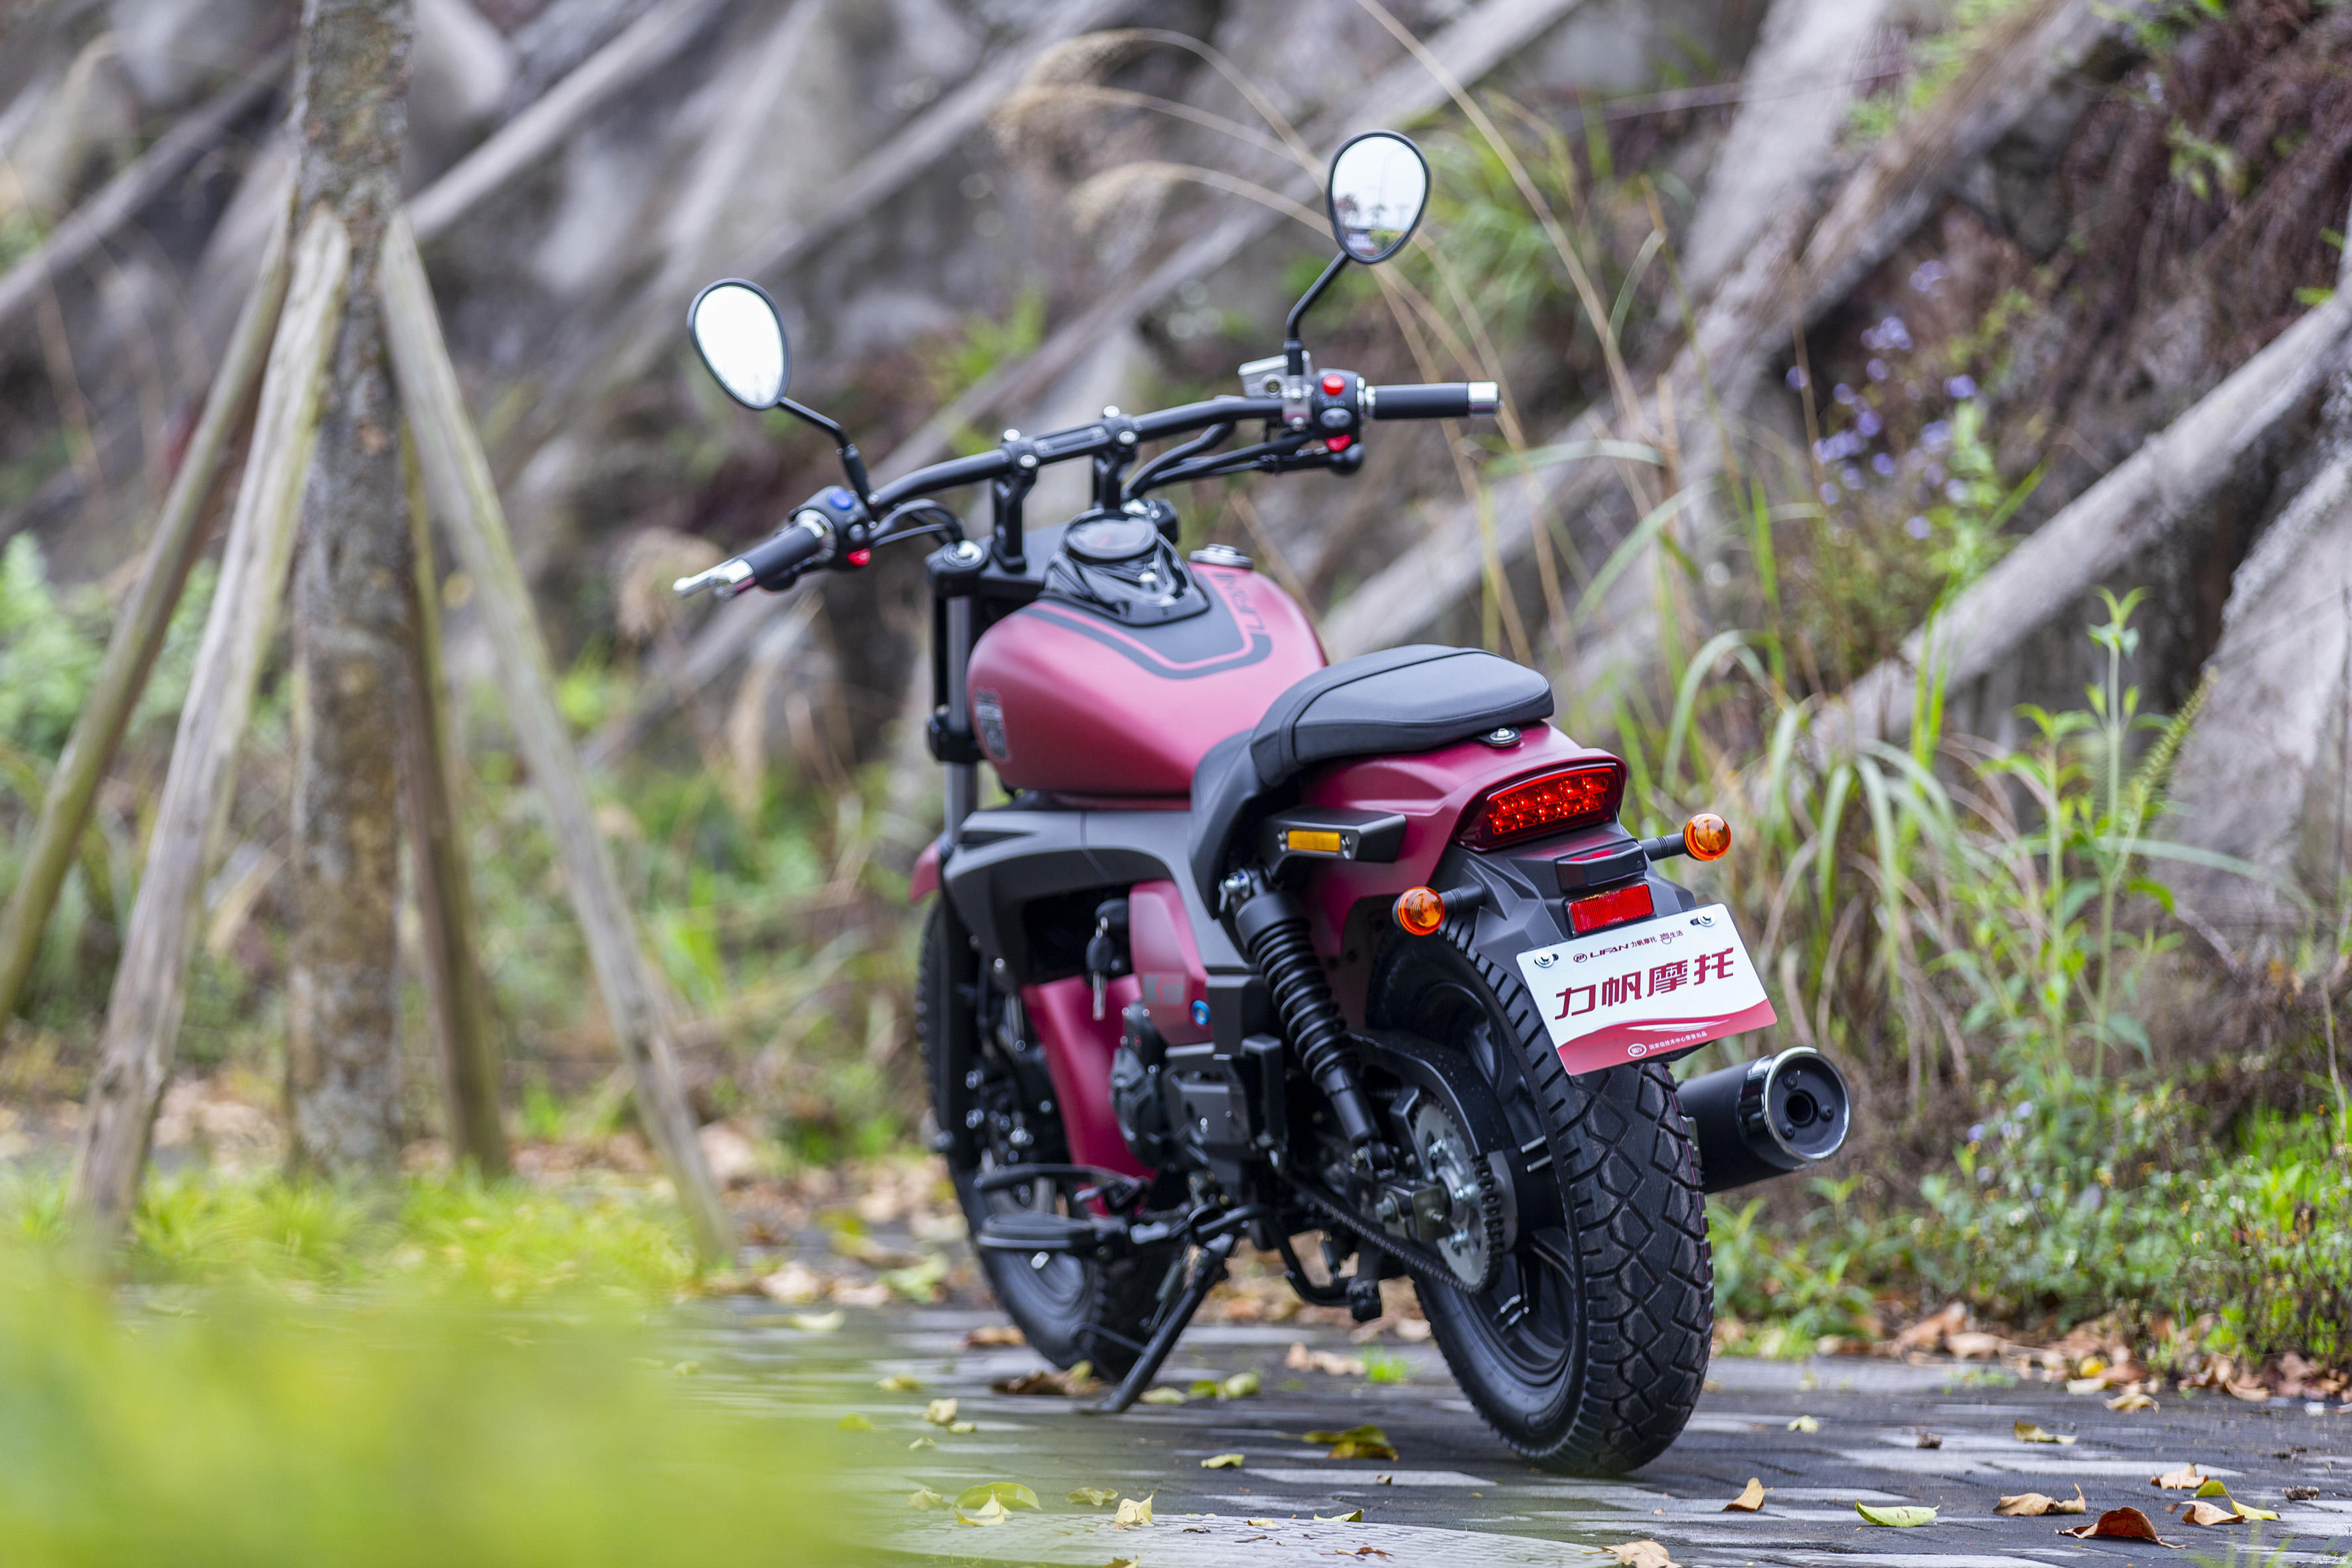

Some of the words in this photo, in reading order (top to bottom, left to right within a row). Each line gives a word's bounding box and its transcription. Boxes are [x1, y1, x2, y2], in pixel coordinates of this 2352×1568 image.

[1590, 943, 1629, 958] LIFAN
[1555, 947, 1734, 1020] 力帆摩托
